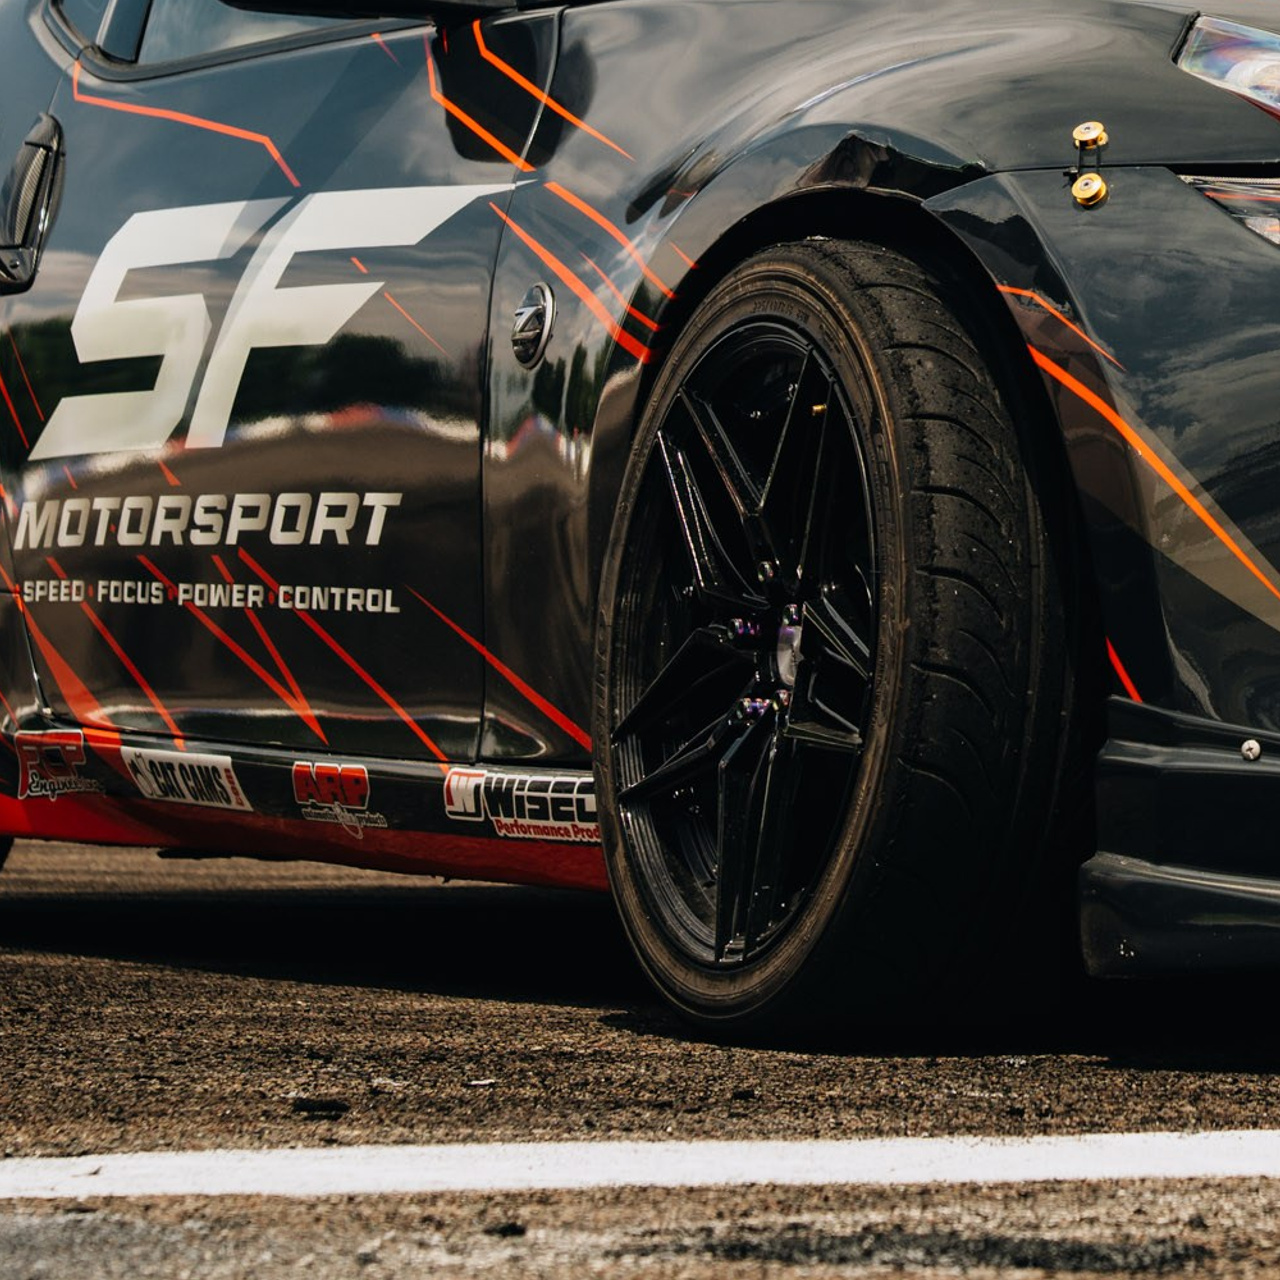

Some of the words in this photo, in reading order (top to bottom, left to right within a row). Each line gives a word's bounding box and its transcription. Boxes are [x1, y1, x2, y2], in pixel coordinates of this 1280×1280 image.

[28, 180, 538, 461] SF
[13, 492, 403, 551] MOTORSPORT
[23, 580, 85, 602] SPEED
[98, 580, 164, 604] FOCUS
[178, 583, 264, 608] POWER
[278, 585, 401, 613] CONTROL
[293, 762, 369, 809] ARP
[484, 775, 600, 823] WISEC
[495, 819, 571, 839] Performance
[572, 824, 600, 841] Prod
